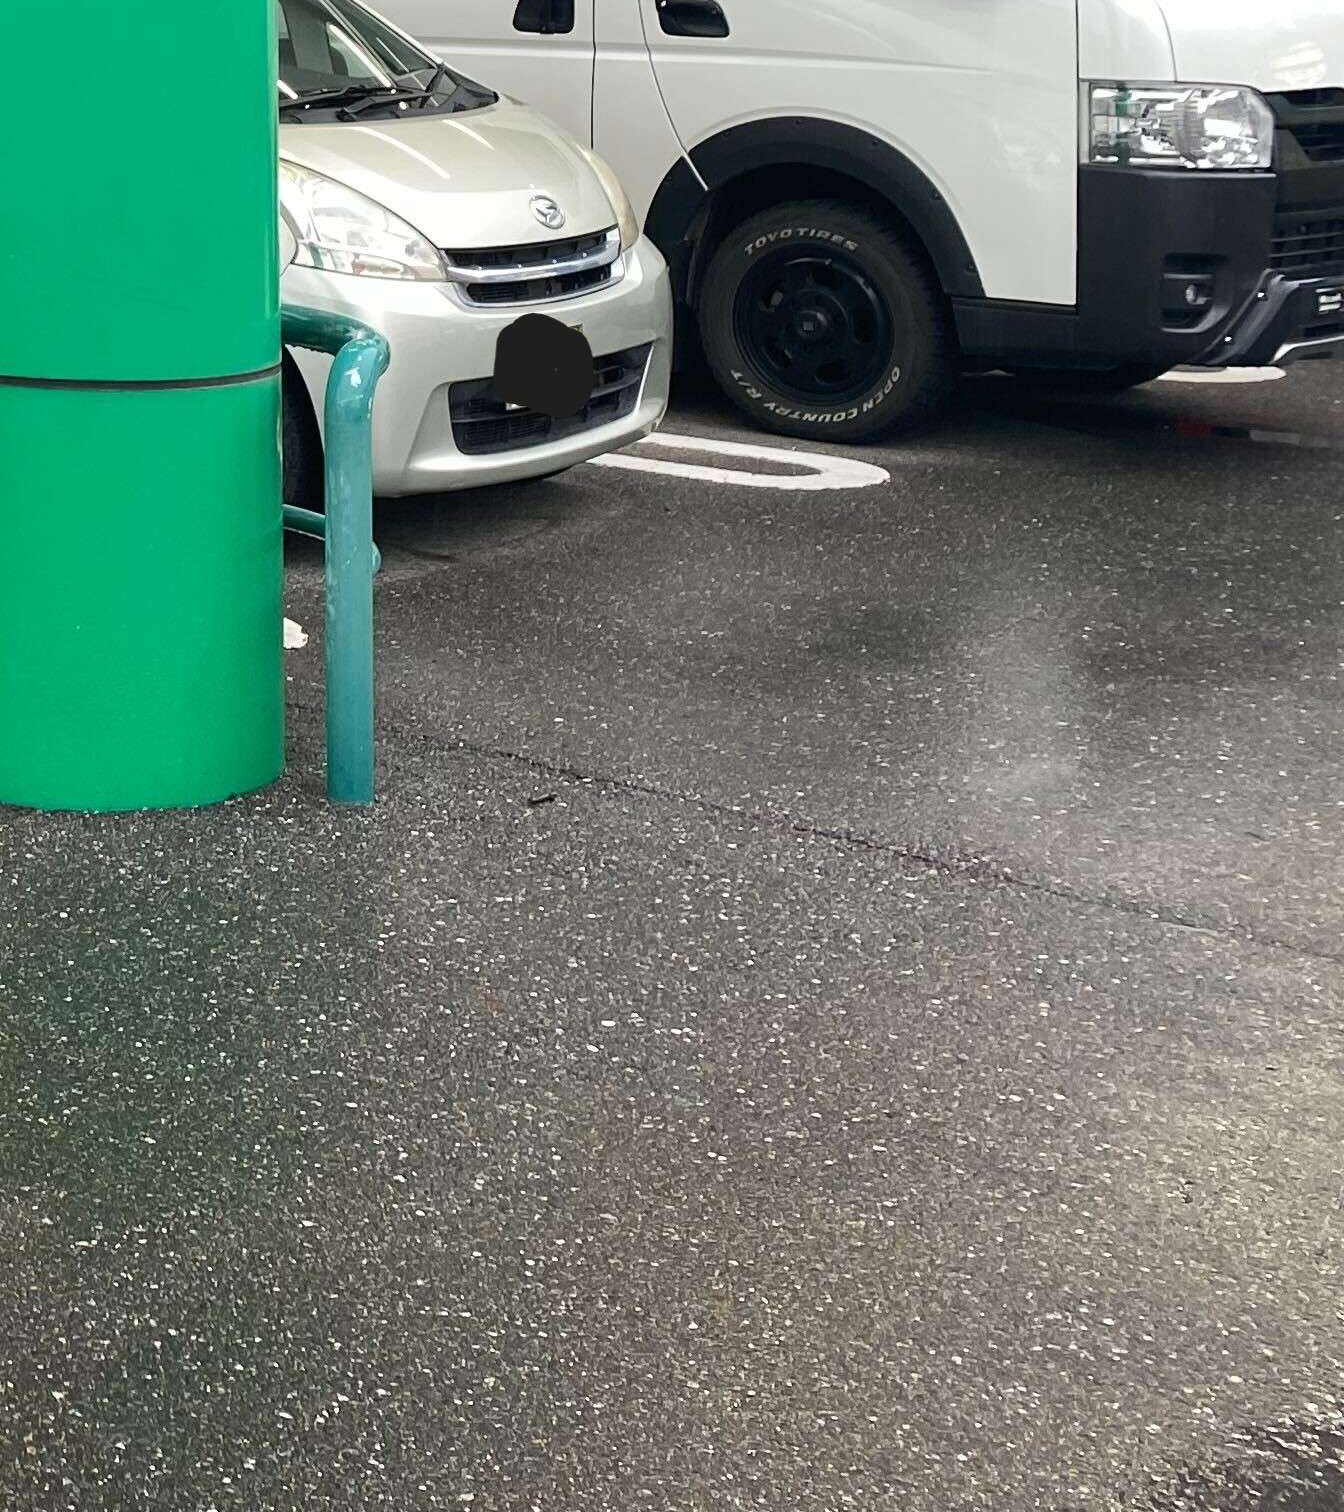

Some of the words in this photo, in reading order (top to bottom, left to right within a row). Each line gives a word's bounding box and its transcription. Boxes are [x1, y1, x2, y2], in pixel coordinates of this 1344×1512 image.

[744, 228, 793, 257] TOYO
[795, 227, 860, 252] TIRES
[863, 365, 901, 414] OPEN
[764, 400, 858, 423] COUNTRY
